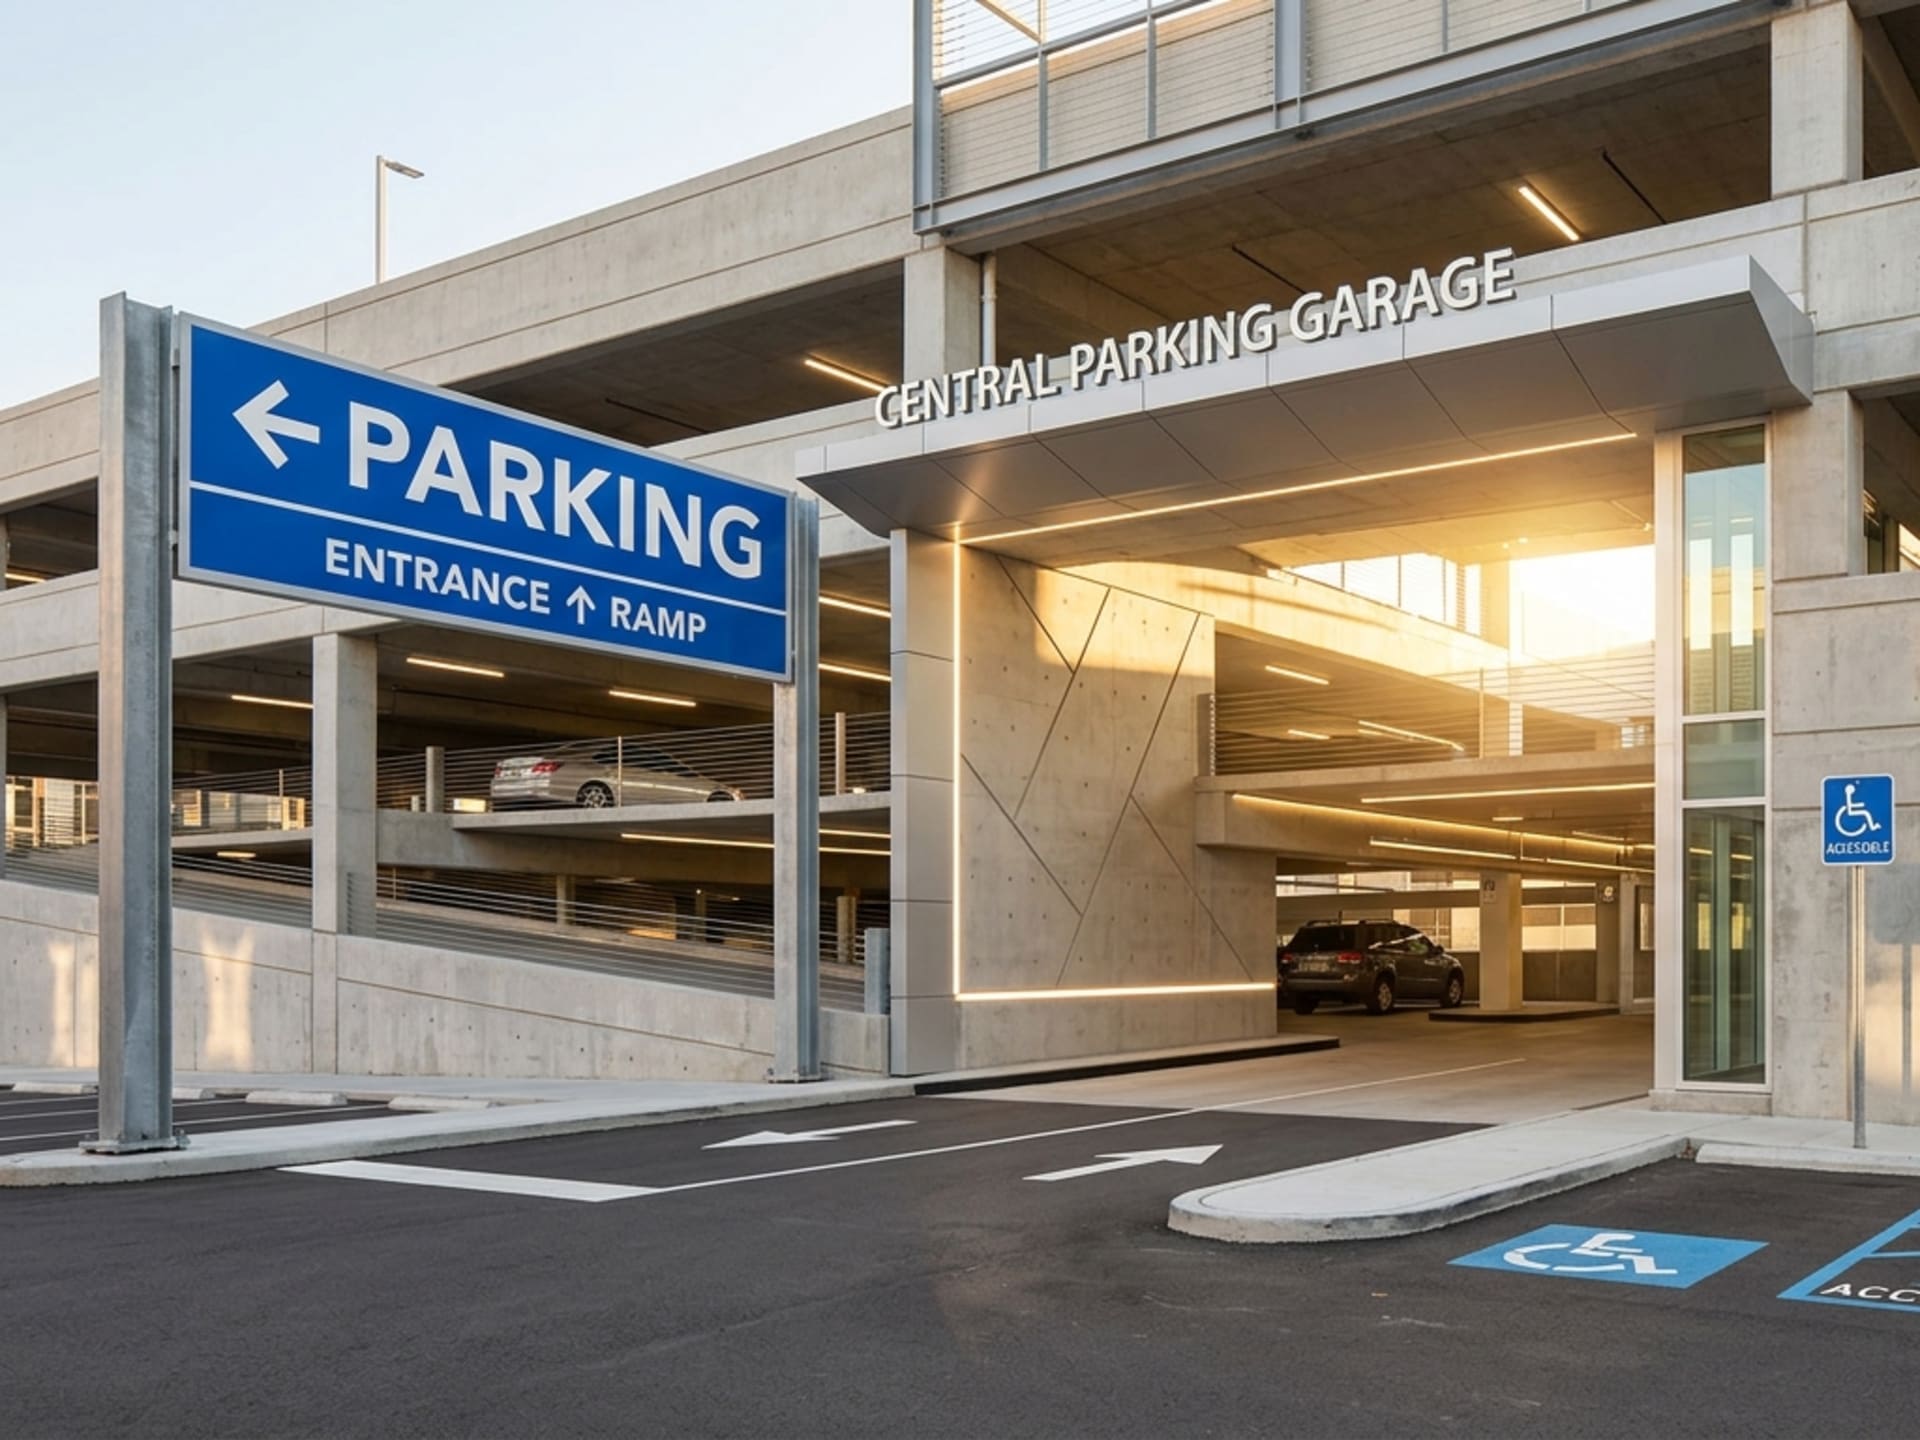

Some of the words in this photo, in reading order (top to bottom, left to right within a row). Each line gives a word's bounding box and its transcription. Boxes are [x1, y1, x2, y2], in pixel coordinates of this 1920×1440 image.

[874, 353, 1060, 429] CENTRAL
[1069, 302, 1274, 388] PARKING
[1287, 246, 1517, 341] GARAGE
[348, 401, 763, 581] PARKING
[325, 538, 551, 615] ENTRANCE
[611, 596, 706, 642] RAMP
